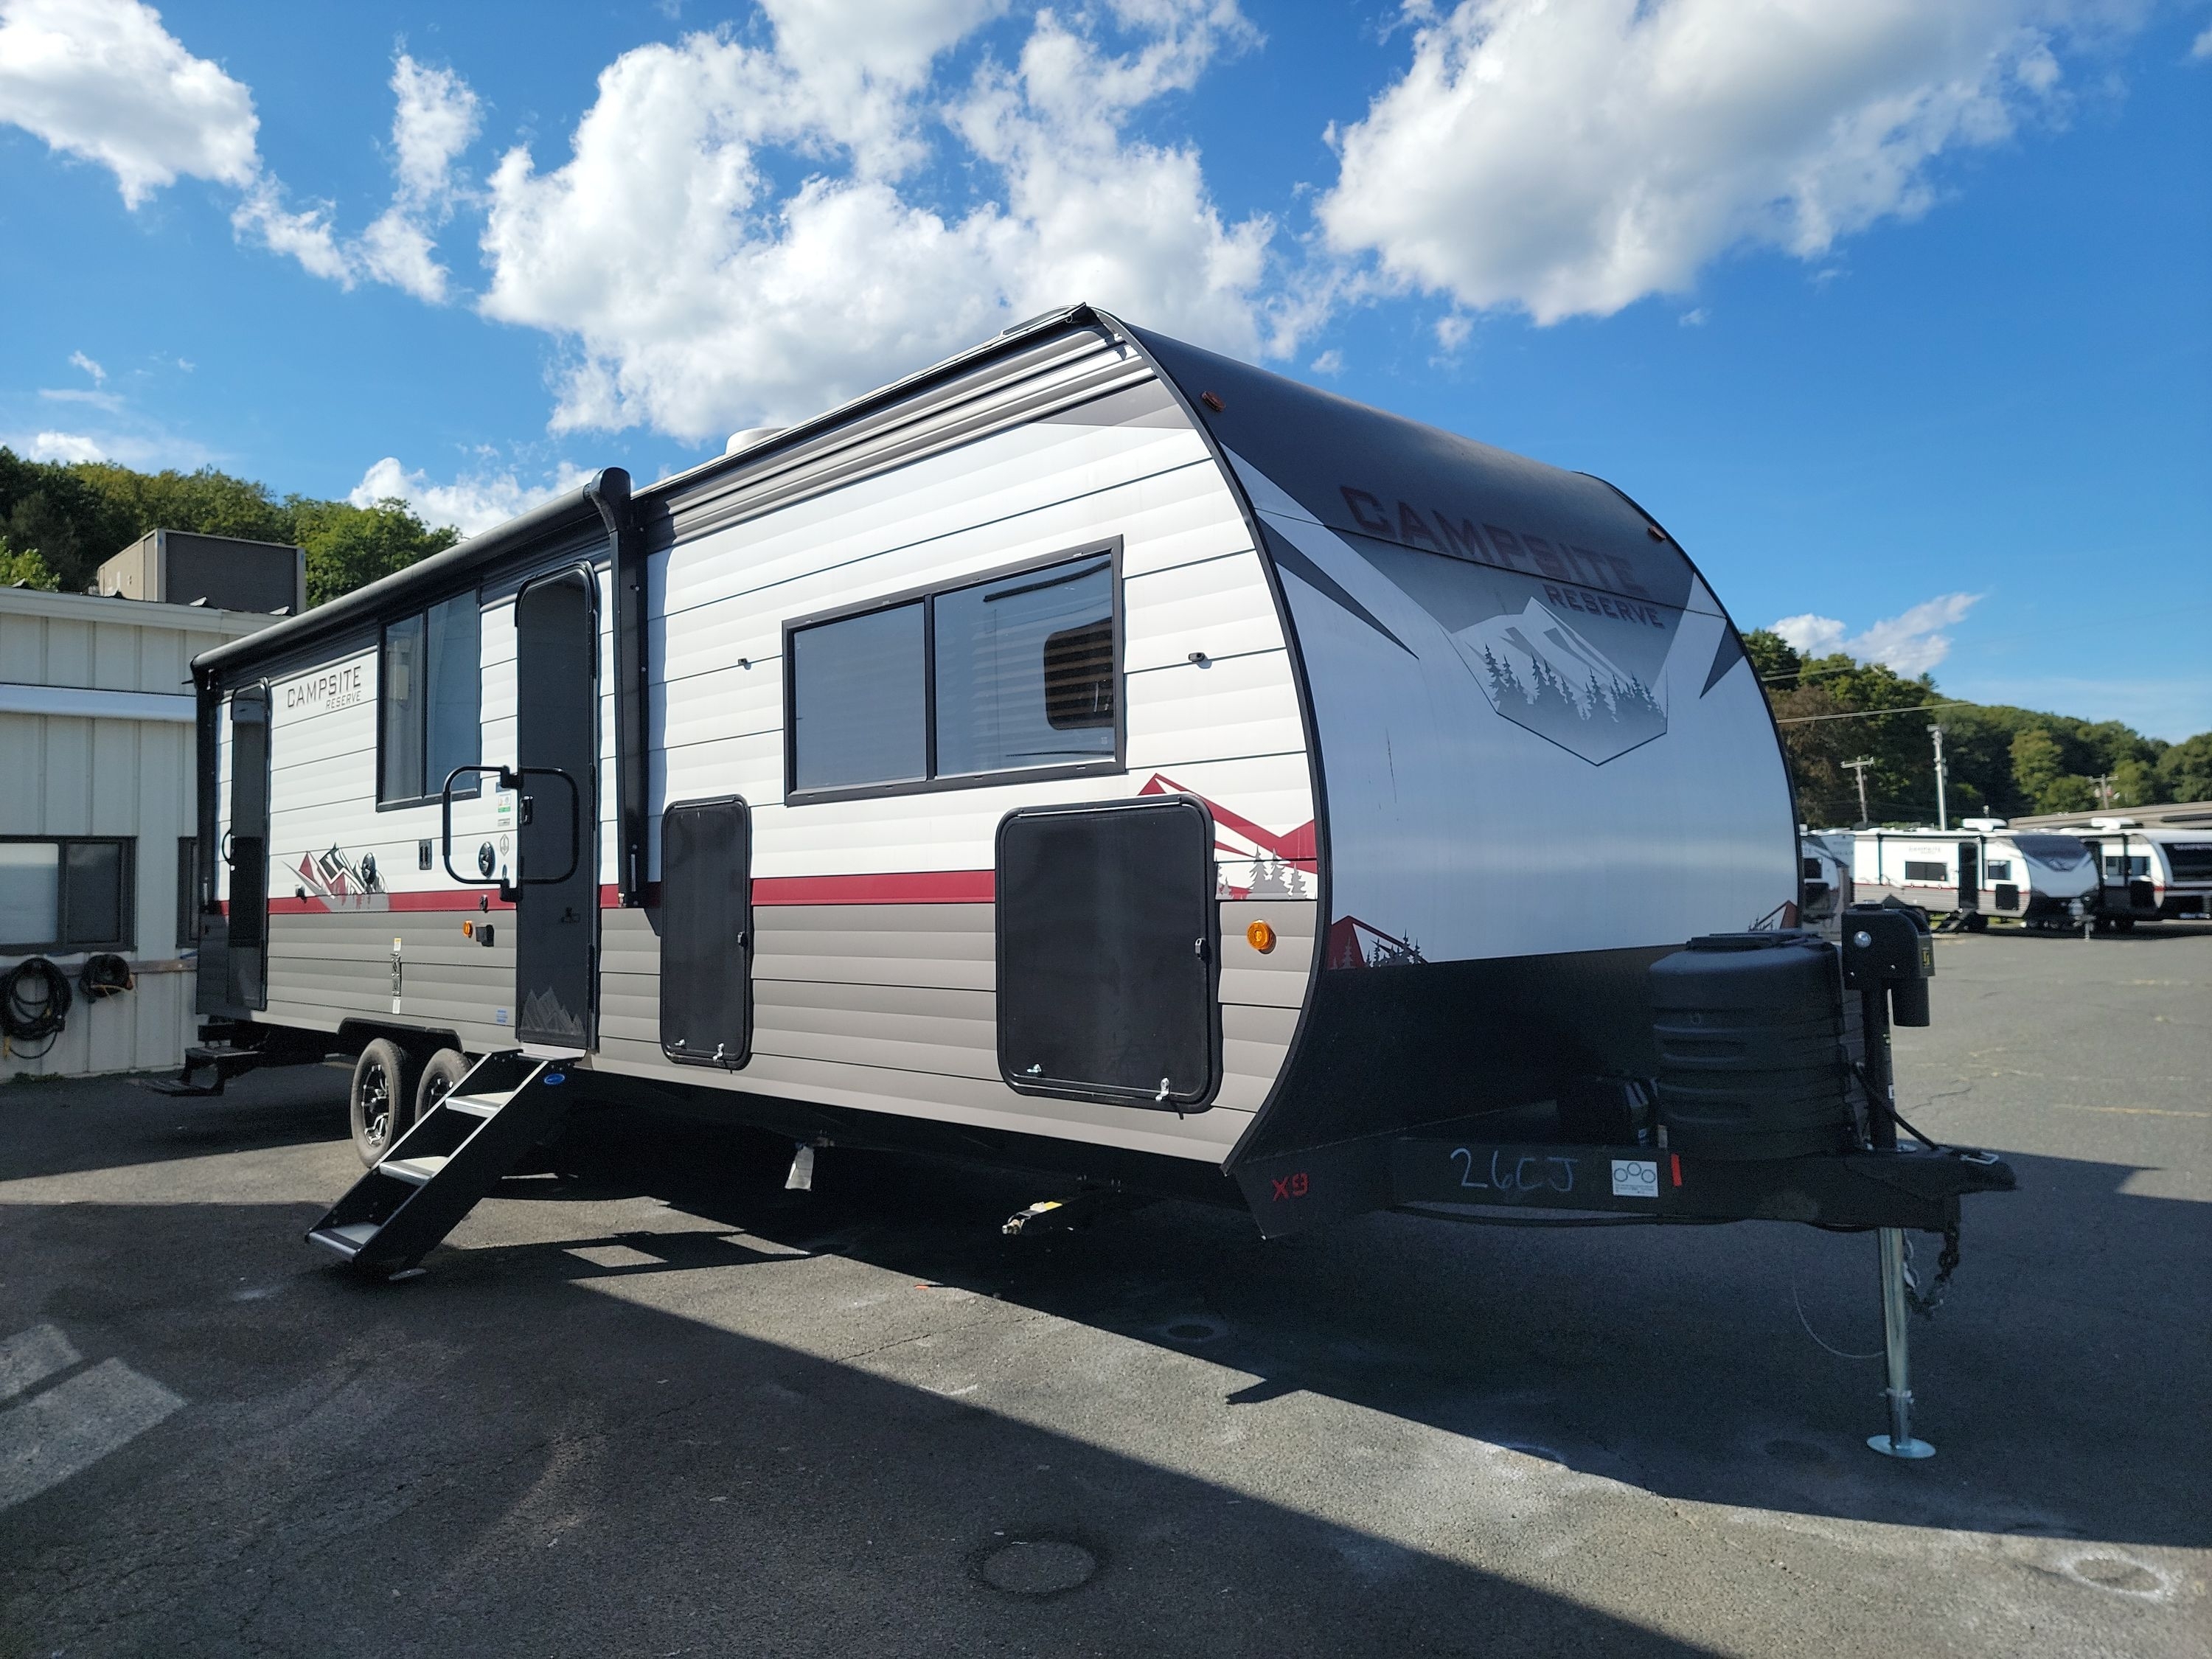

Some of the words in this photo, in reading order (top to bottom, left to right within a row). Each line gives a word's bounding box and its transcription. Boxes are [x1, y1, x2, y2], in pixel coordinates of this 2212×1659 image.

[1340, 486, 1651, 598] CAMPSITE
[1543, 583, 1666, 630] RESERVE
[287, 665, 361, 708] CAMPSITE
[325, 690, 361, 710] RESERVE
